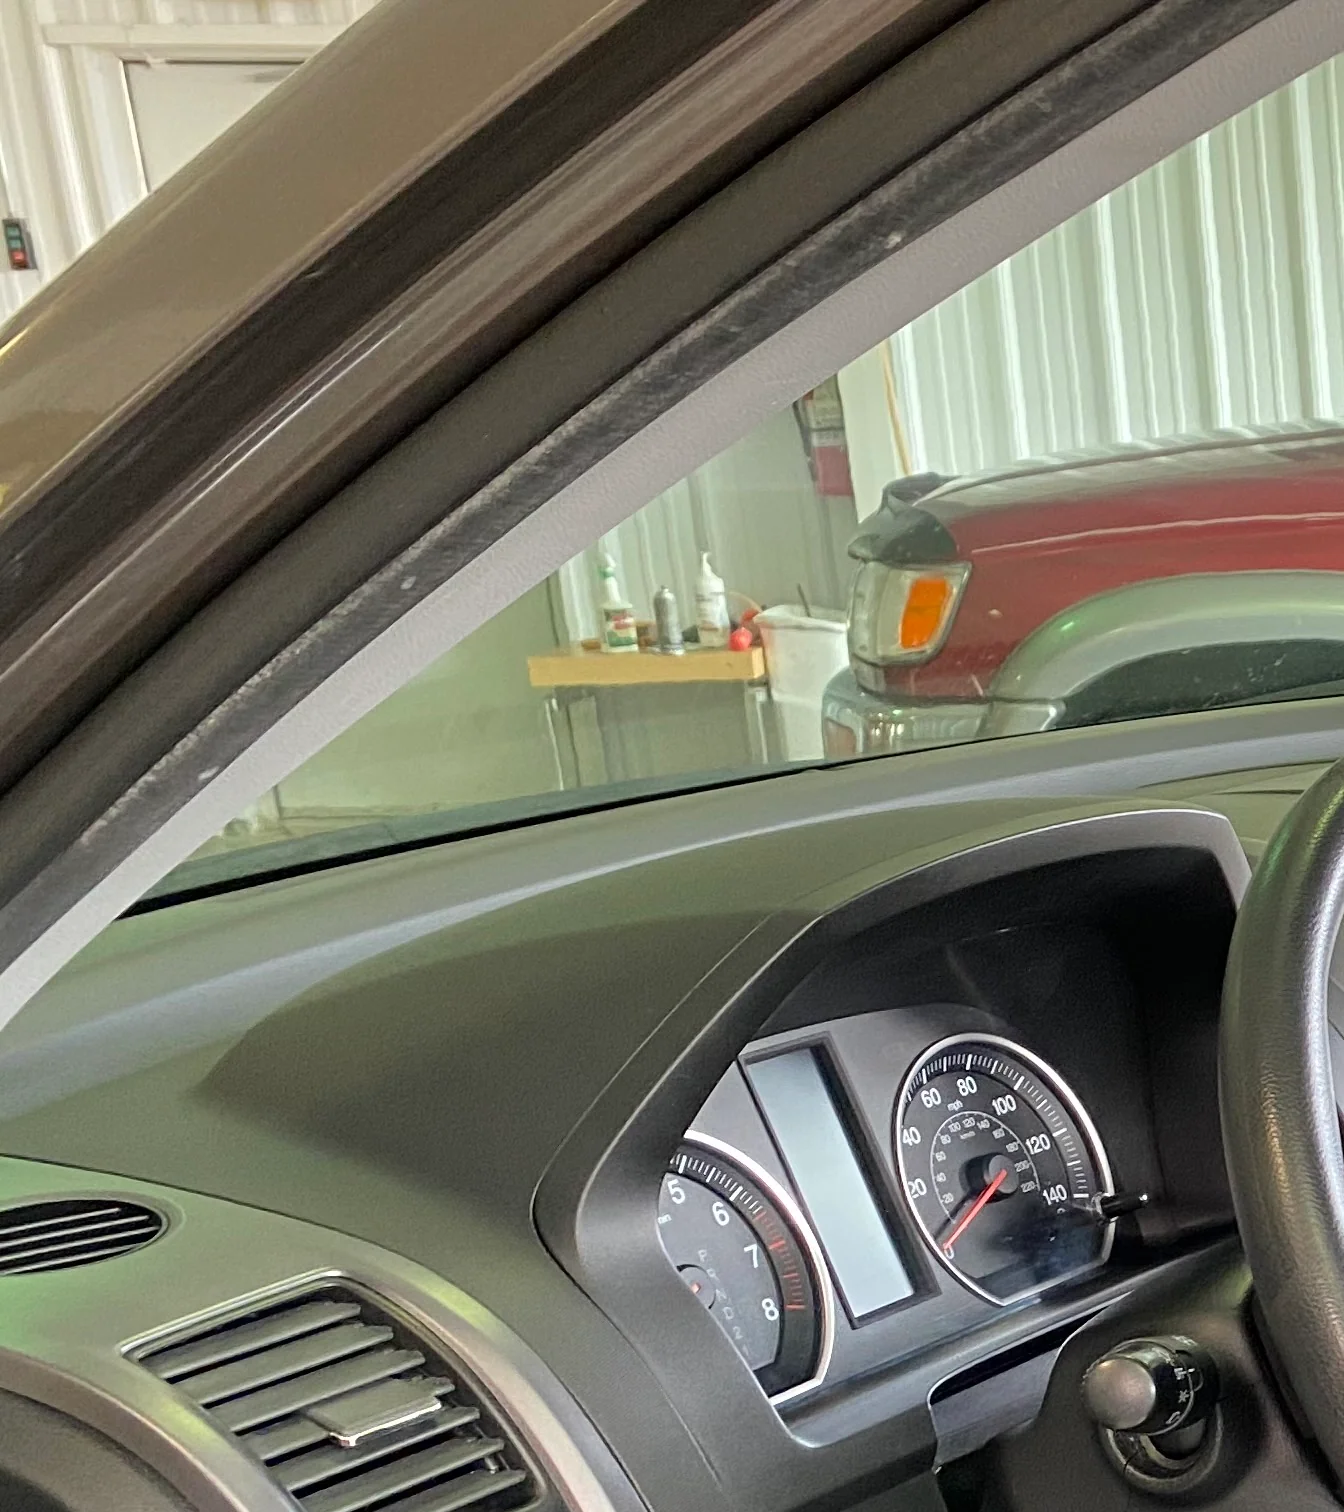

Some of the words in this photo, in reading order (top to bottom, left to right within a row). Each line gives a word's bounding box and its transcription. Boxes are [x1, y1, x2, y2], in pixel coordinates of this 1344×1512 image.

[956, 1076, 977, 1096] 80
[921, 1088, 941, 1108] 60
[992, 1095, 1017, 1115] 100
[903, 1127, 921, 1146] 40
[1026, 1134, 1050, 1154] 120
[667, 1179, 686, 1205] 5
[908, 1178, 927, 1199] 20
[1043, 1185, 1067, 1205] 140
[712, 1201, 729, 1226] 6
[743, 1243, 759, 1269] 7
[761, 1298, 779, 1321] 8
